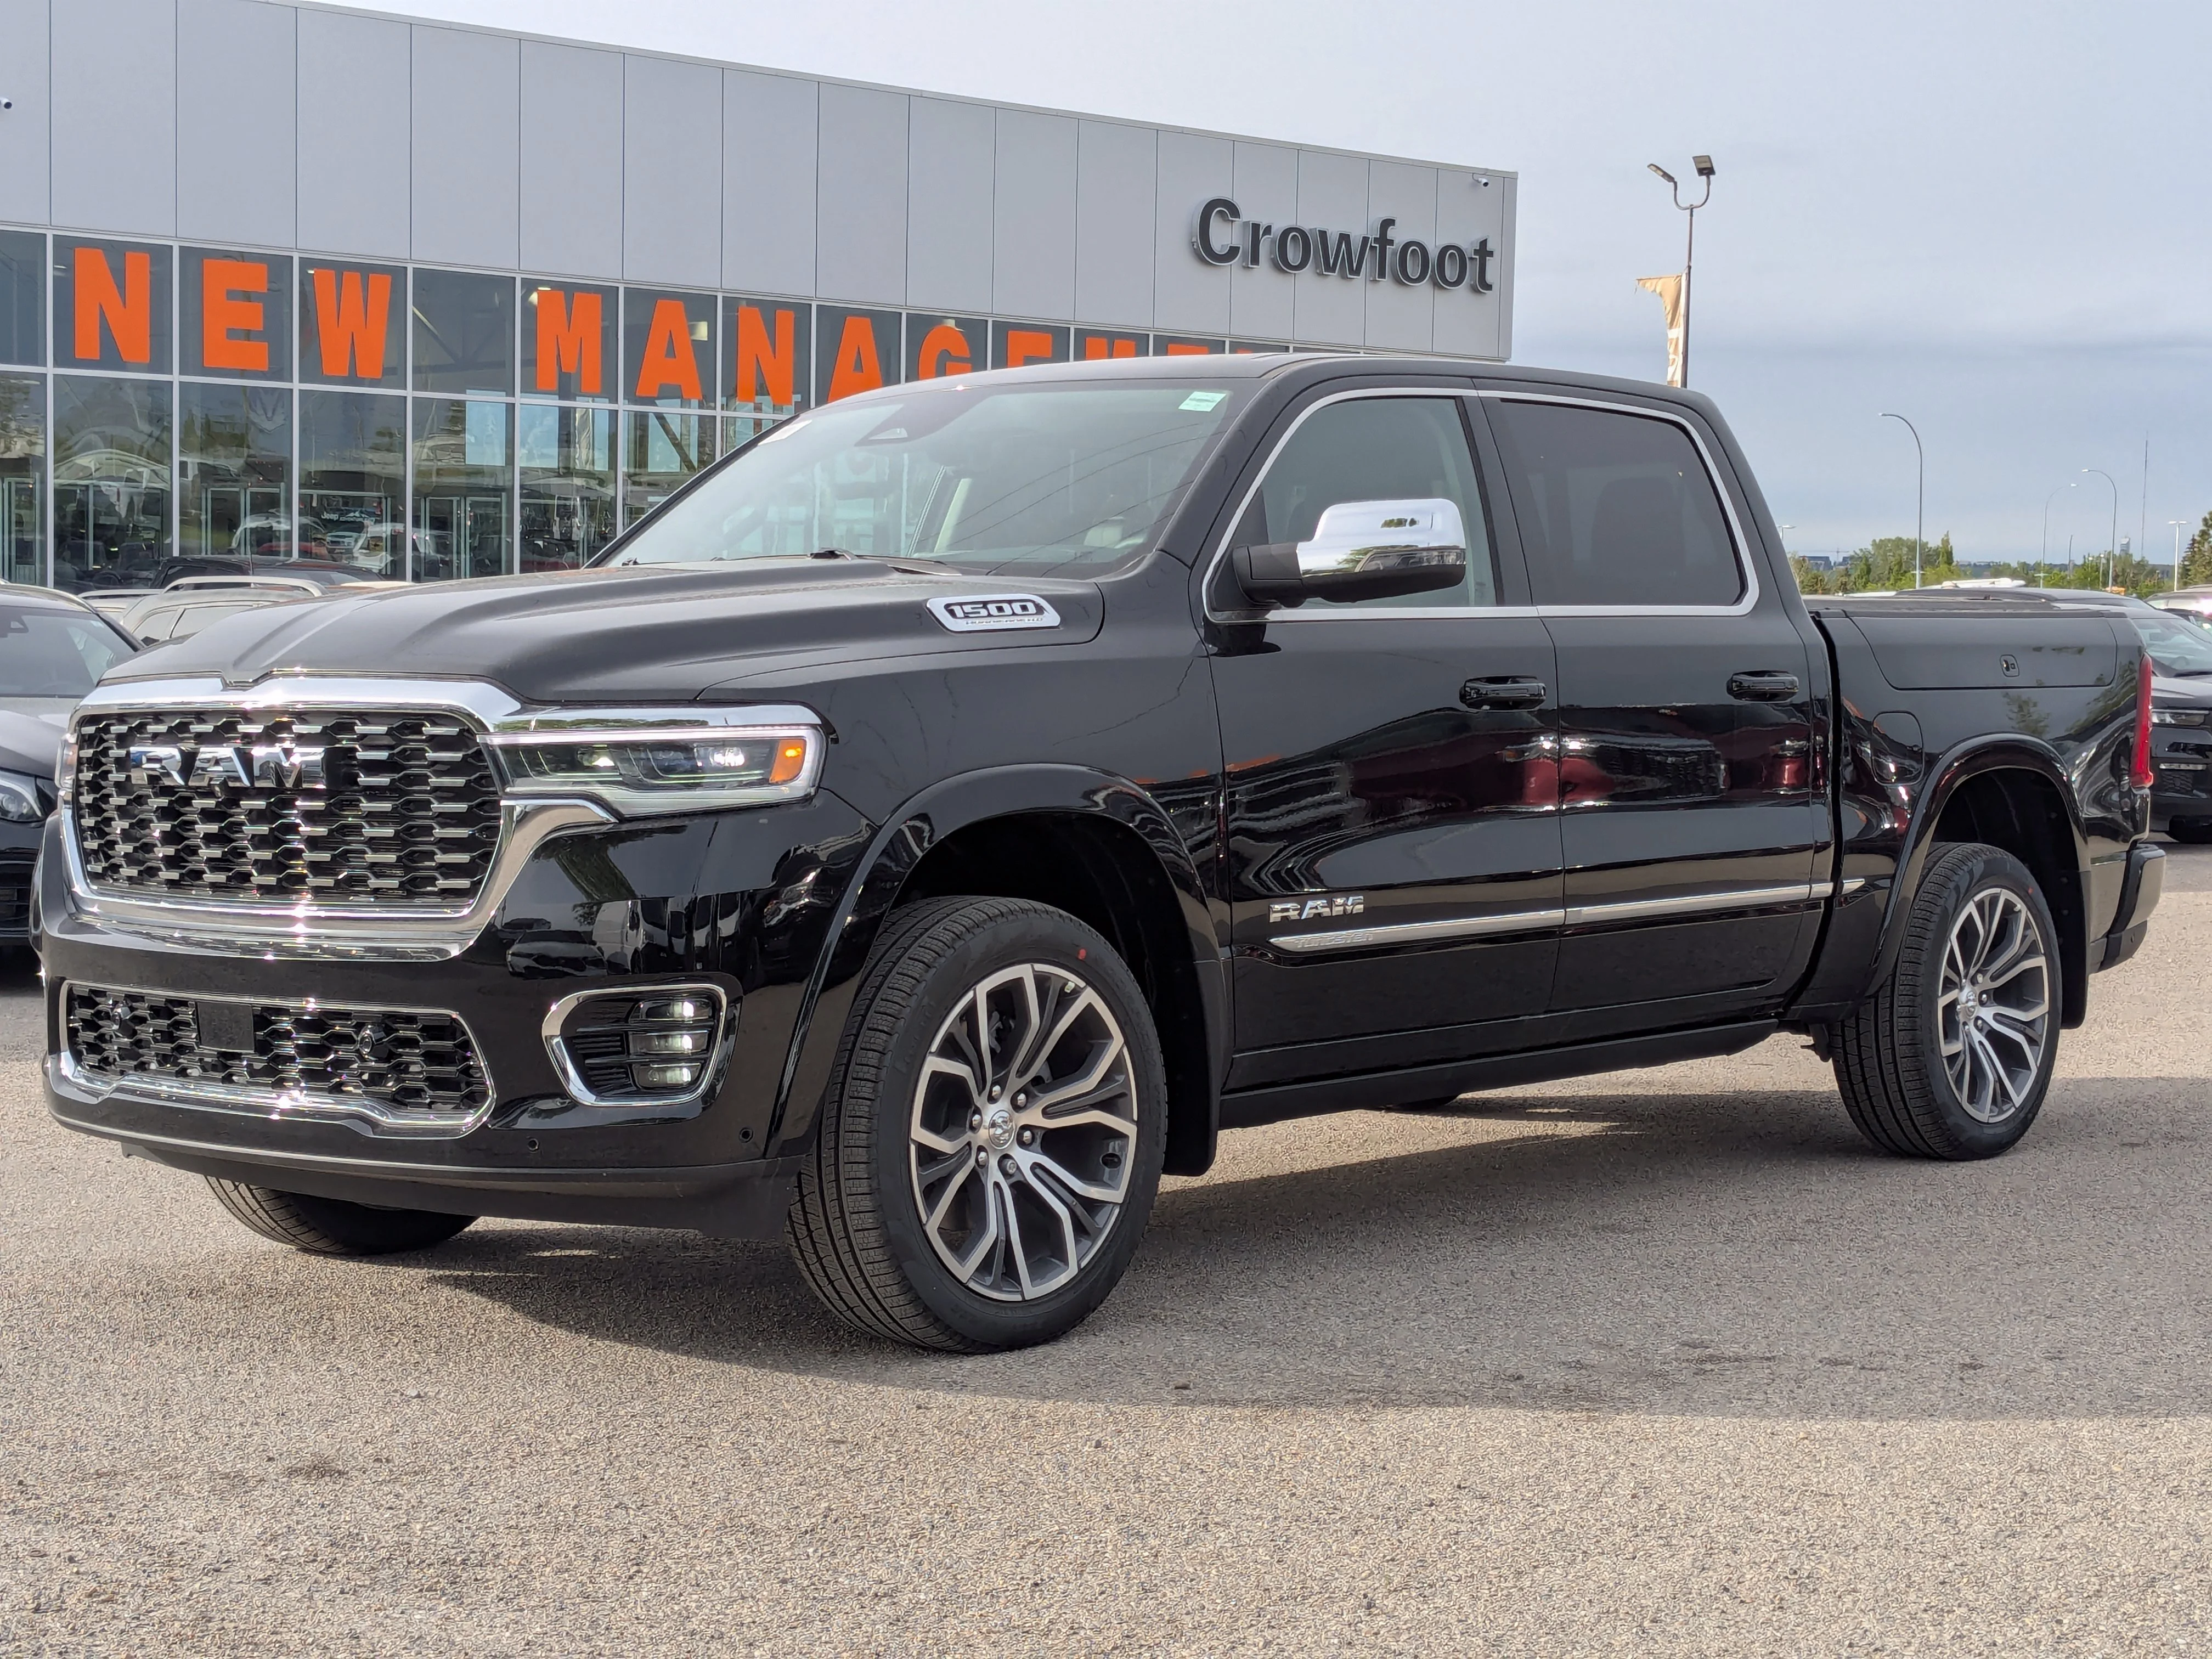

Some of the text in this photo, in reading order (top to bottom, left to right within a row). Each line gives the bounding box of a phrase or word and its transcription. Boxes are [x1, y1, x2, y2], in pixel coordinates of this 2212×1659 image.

[1195, 196, 1494, 293] Crowfoot
[74, 247, 1253, 406] NEW MANAG
[947, 602, 1037, 618] 1500
[129, 746, 326, 788] RAM
[1269, 895, 1364, 923] RAM
